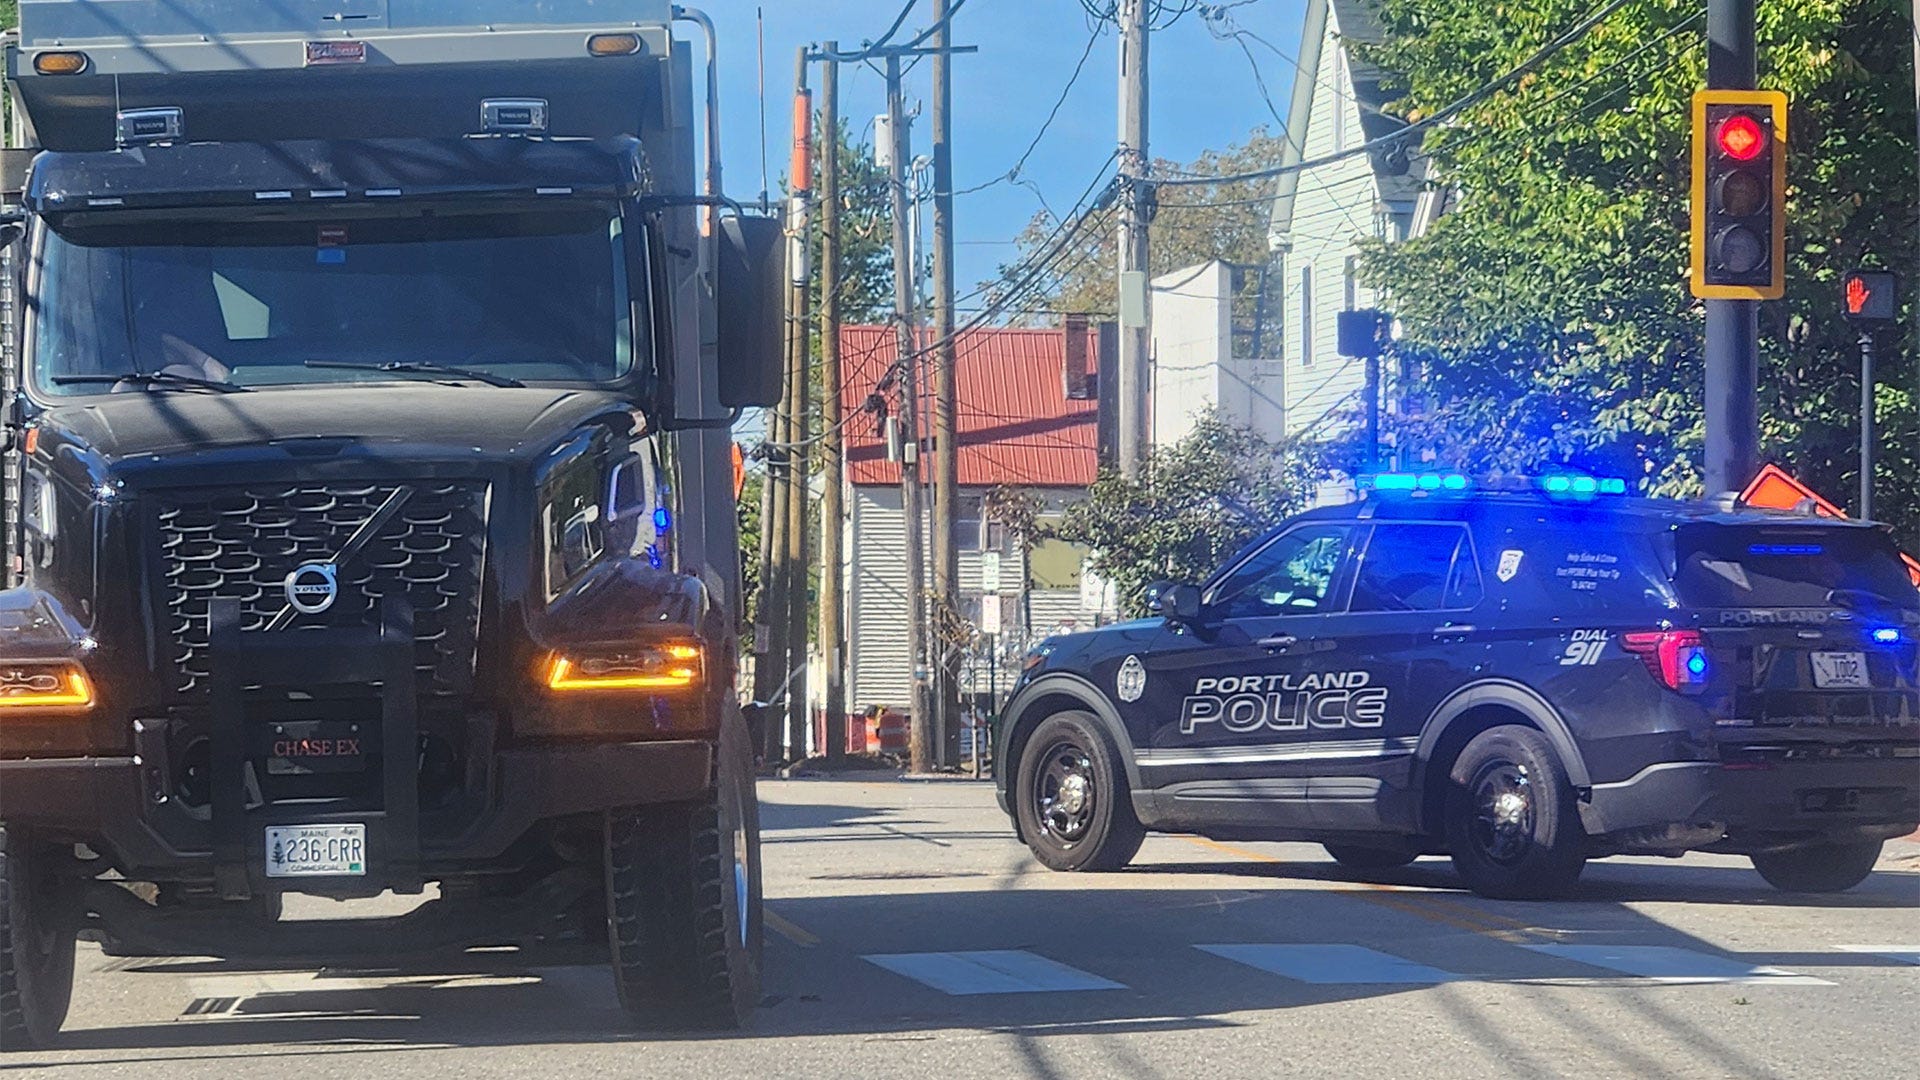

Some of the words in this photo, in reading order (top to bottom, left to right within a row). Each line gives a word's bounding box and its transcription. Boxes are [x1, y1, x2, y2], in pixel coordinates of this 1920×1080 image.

[1720, 611, 1828, 623] PORTLAND
[1571, 629, 1609, 641] DIAL
[1560, 641, 1606, 665] 911
[1195, 671, 1370, 695] PORTLAND
[1180, 687, 1388, 735] POLICE
[274, 740, 332, 756] CHASE
[336, 739, 360, 755] EX
[301, 830, 329, 838] MAINE
